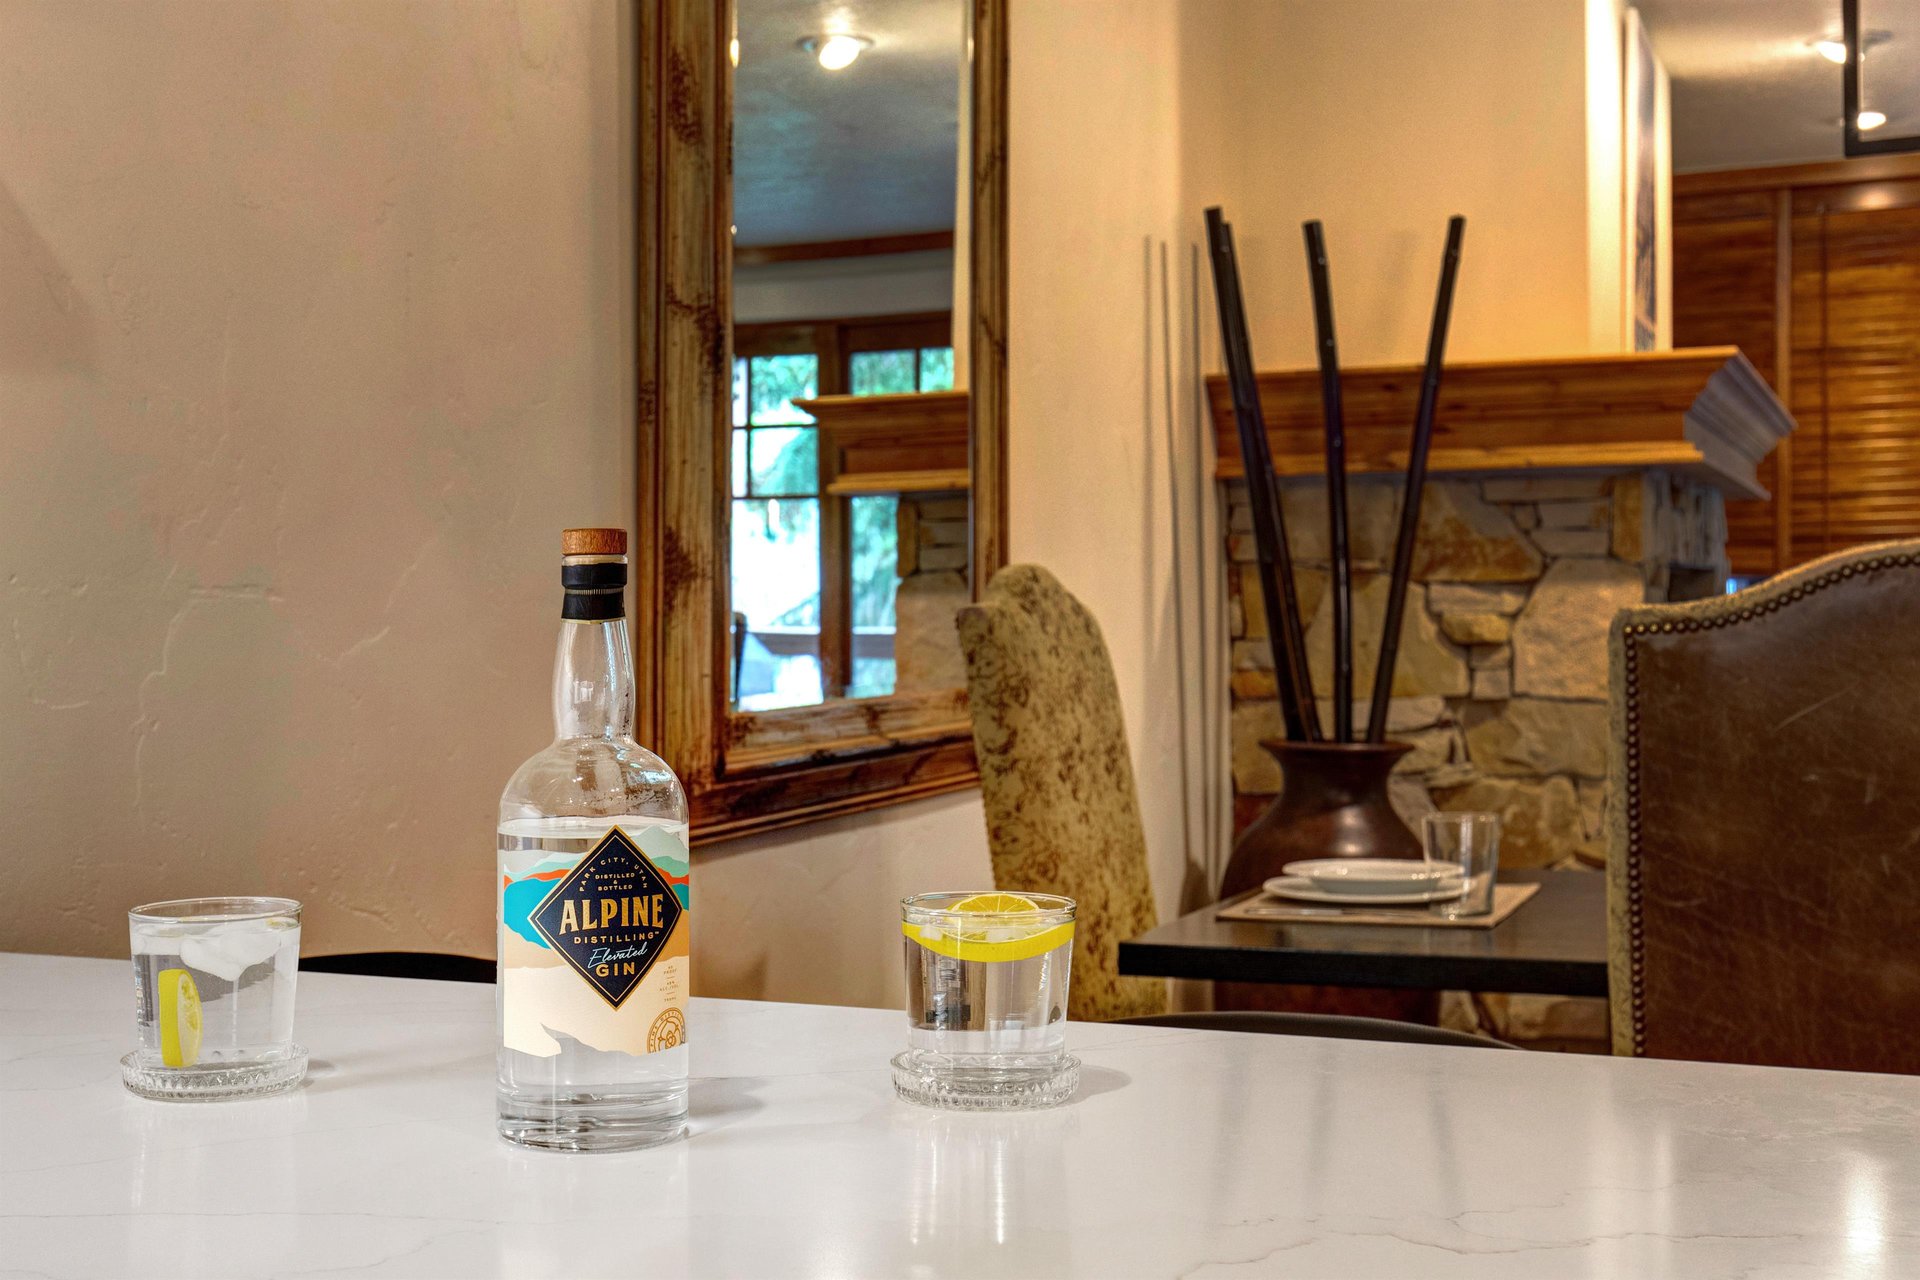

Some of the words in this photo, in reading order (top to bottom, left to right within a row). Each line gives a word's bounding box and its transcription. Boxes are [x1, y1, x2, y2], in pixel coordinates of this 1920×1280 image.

[579, 866, 596, 892] PARK
[600, 857, 629, 866] CITY,
[634, 864, 648, 888] UTAH
[595, 872, 635, 880] DISTILLED
[597, 884, 633, 892] BOTTLED
[559, 894, 663, 935] ALPINE
[574, 931, 655, 944] DISTILLING
[587, 941, 648, 969] Elevated
[595, 962, 635, 977] GIN
